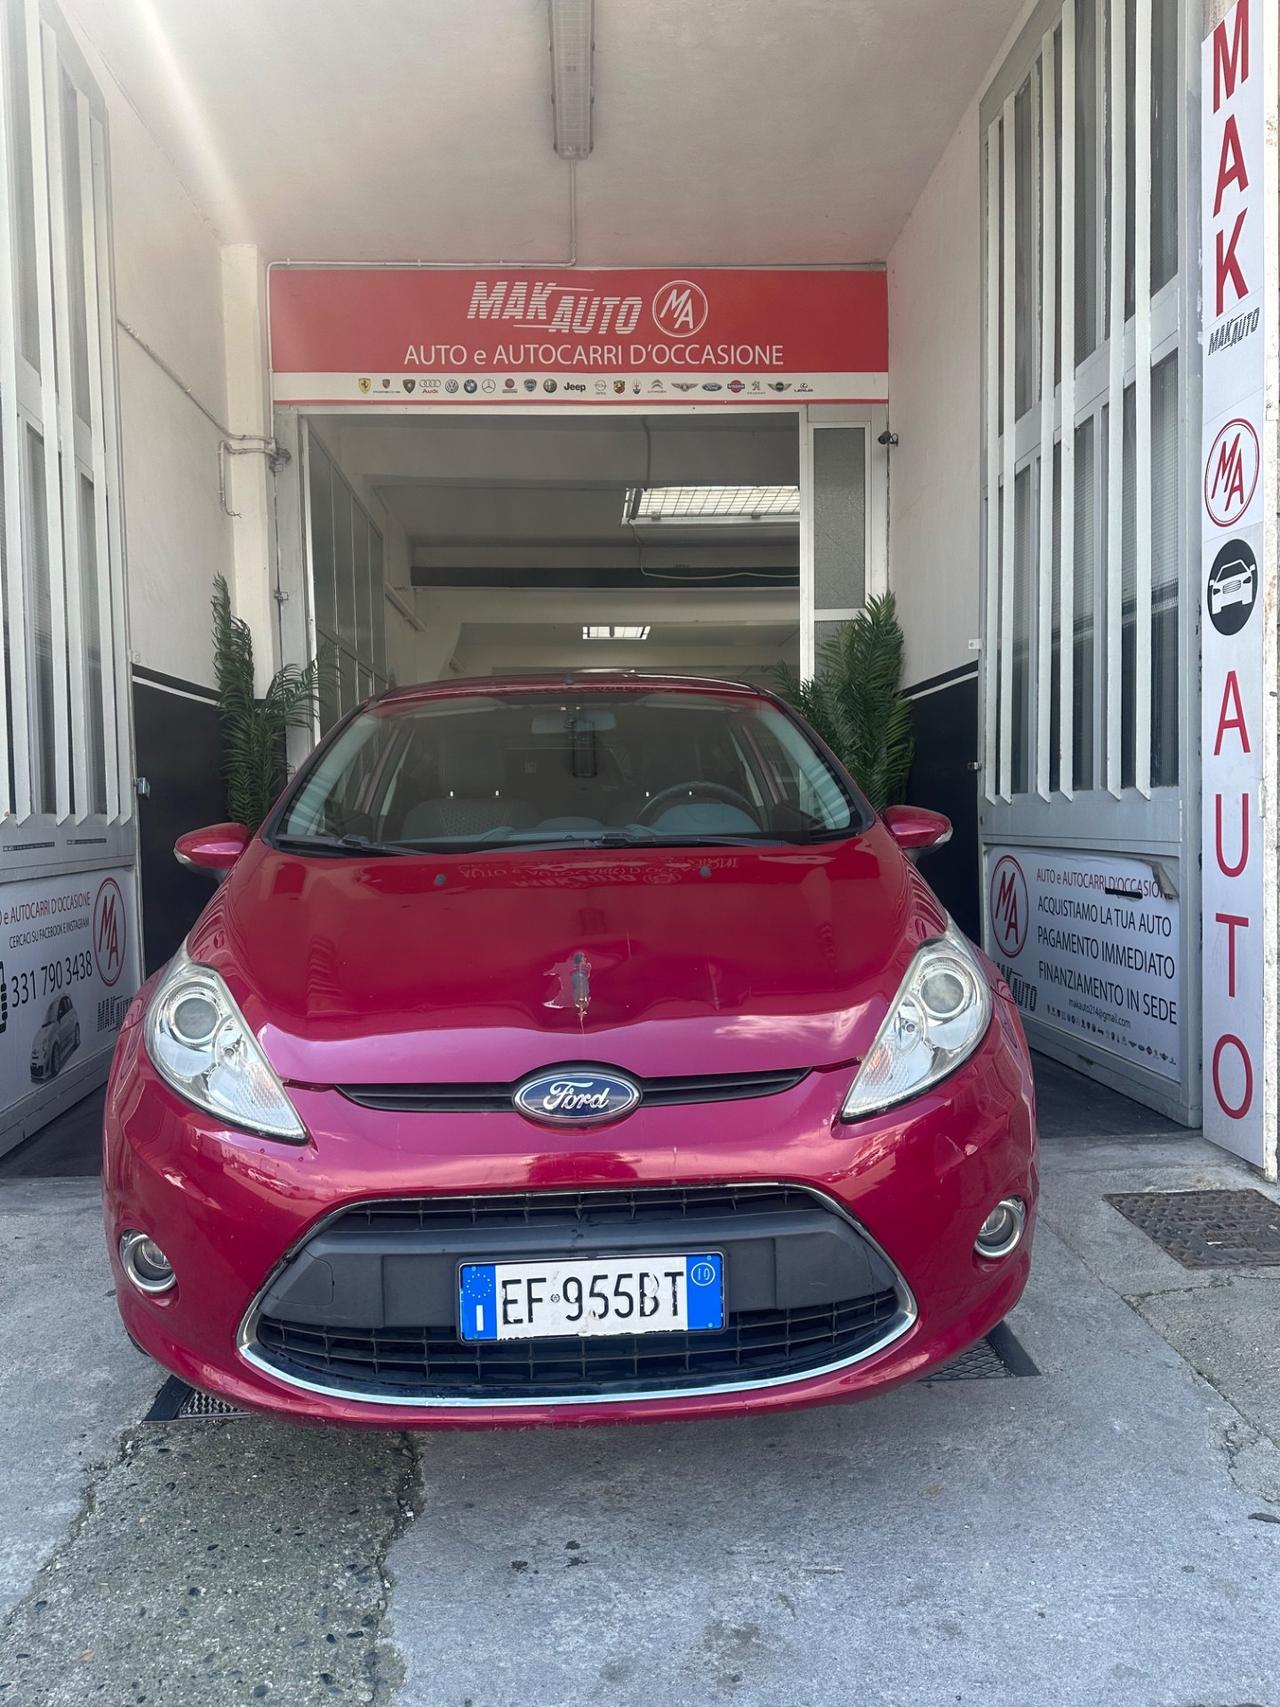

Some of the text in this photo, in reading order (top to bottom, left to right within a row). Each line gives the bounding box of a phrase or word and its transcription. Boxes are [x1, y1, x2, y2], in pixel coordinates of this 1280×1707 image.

[404, 344, 784, 365] AUTO e AUTOCARRI D'OCCASIONE
[564, 382, 586, 392] Jeep
[1036, 868, 1173, 899] AUTO e AUTOCARRI D'OCCASIO
[4, 912, 9, 925] e
[11, 899, 50, 924] AUTOCARRI
[1038, 896, 1172, 937] ACQUISTIAMO LA TUA AUTO
[1037, 925, 1175, 980] PAGAMENTO IMMEDIATO
[11, 949, 93, 1008] 331 790 3438
[1039, 960, 1124, 1007] FINANZIAMENTO
[1127, 988, 1140, 1013] IN
[1143, 993, 1177, 1025] SEDE
[543, 1081, 611, 1110] Ford
[501, 1277, 547, 1325] EF
